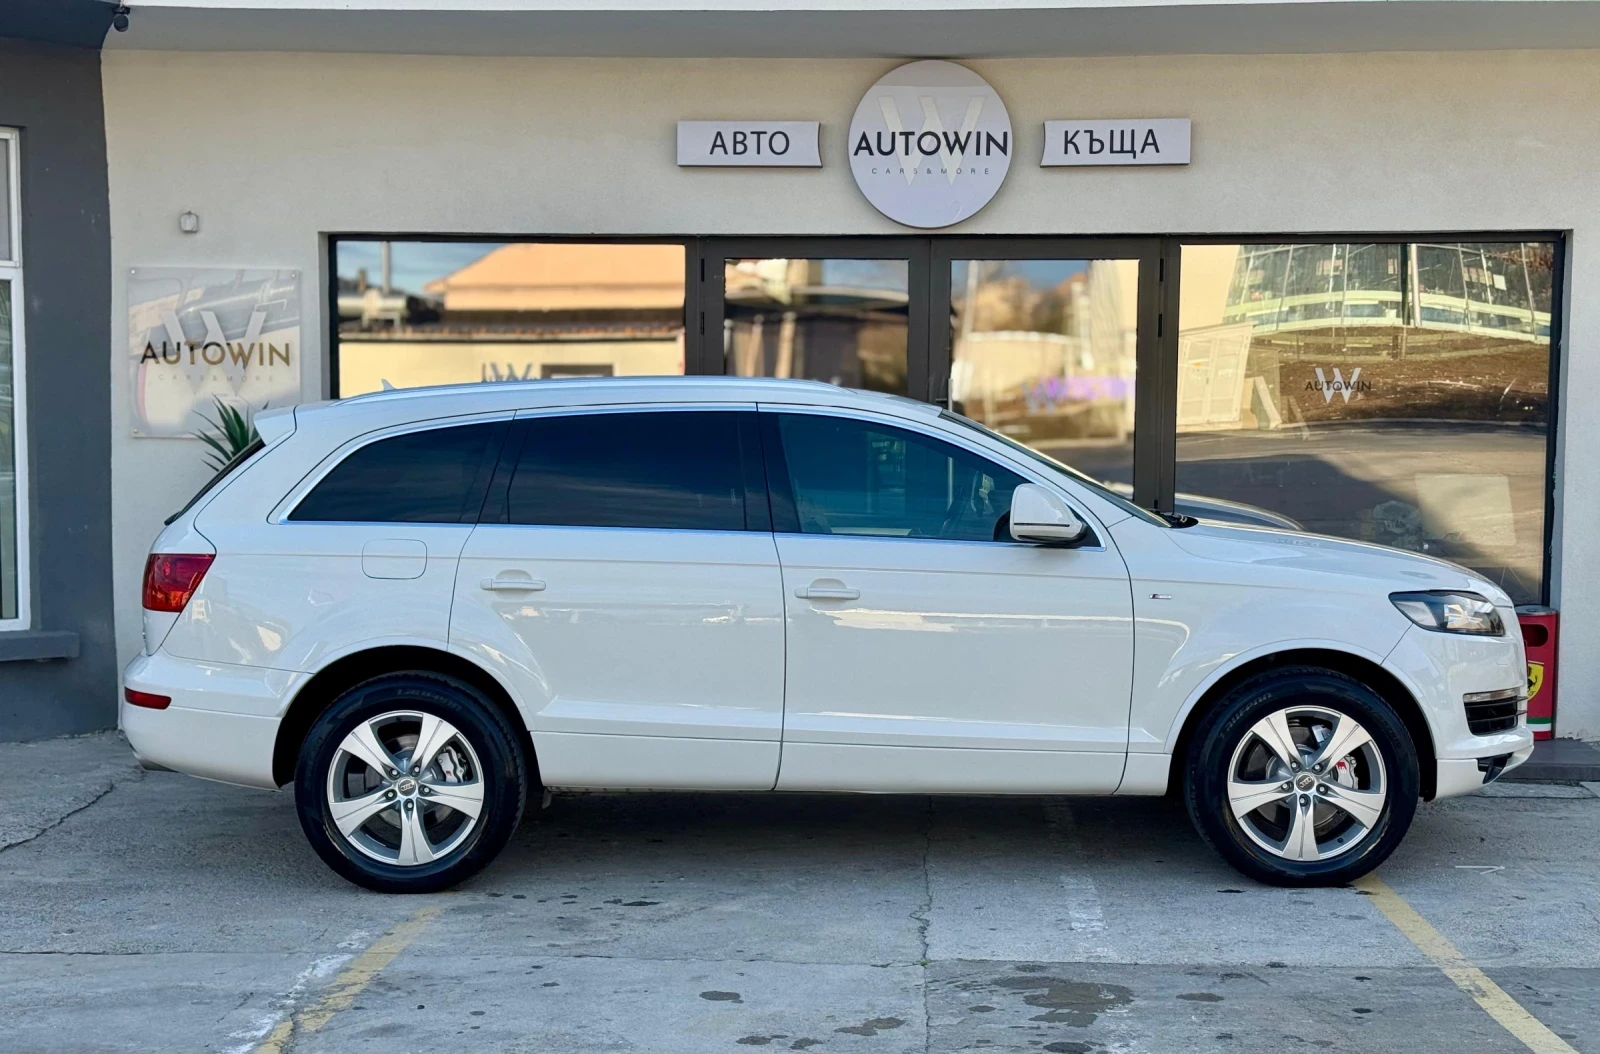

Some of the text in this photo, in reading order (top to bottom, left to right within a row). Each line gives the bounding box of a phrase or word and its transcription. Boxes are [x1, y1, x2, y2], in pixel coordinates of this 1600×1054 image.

[709, 129, 1160, 158] АВТО КЪЩА
[853, 131, 1008, 156] AUTOWIN
[140, 341, 291, 370] AUTOWIN
[1305, 380, 1372, 391] AUTOWIN
